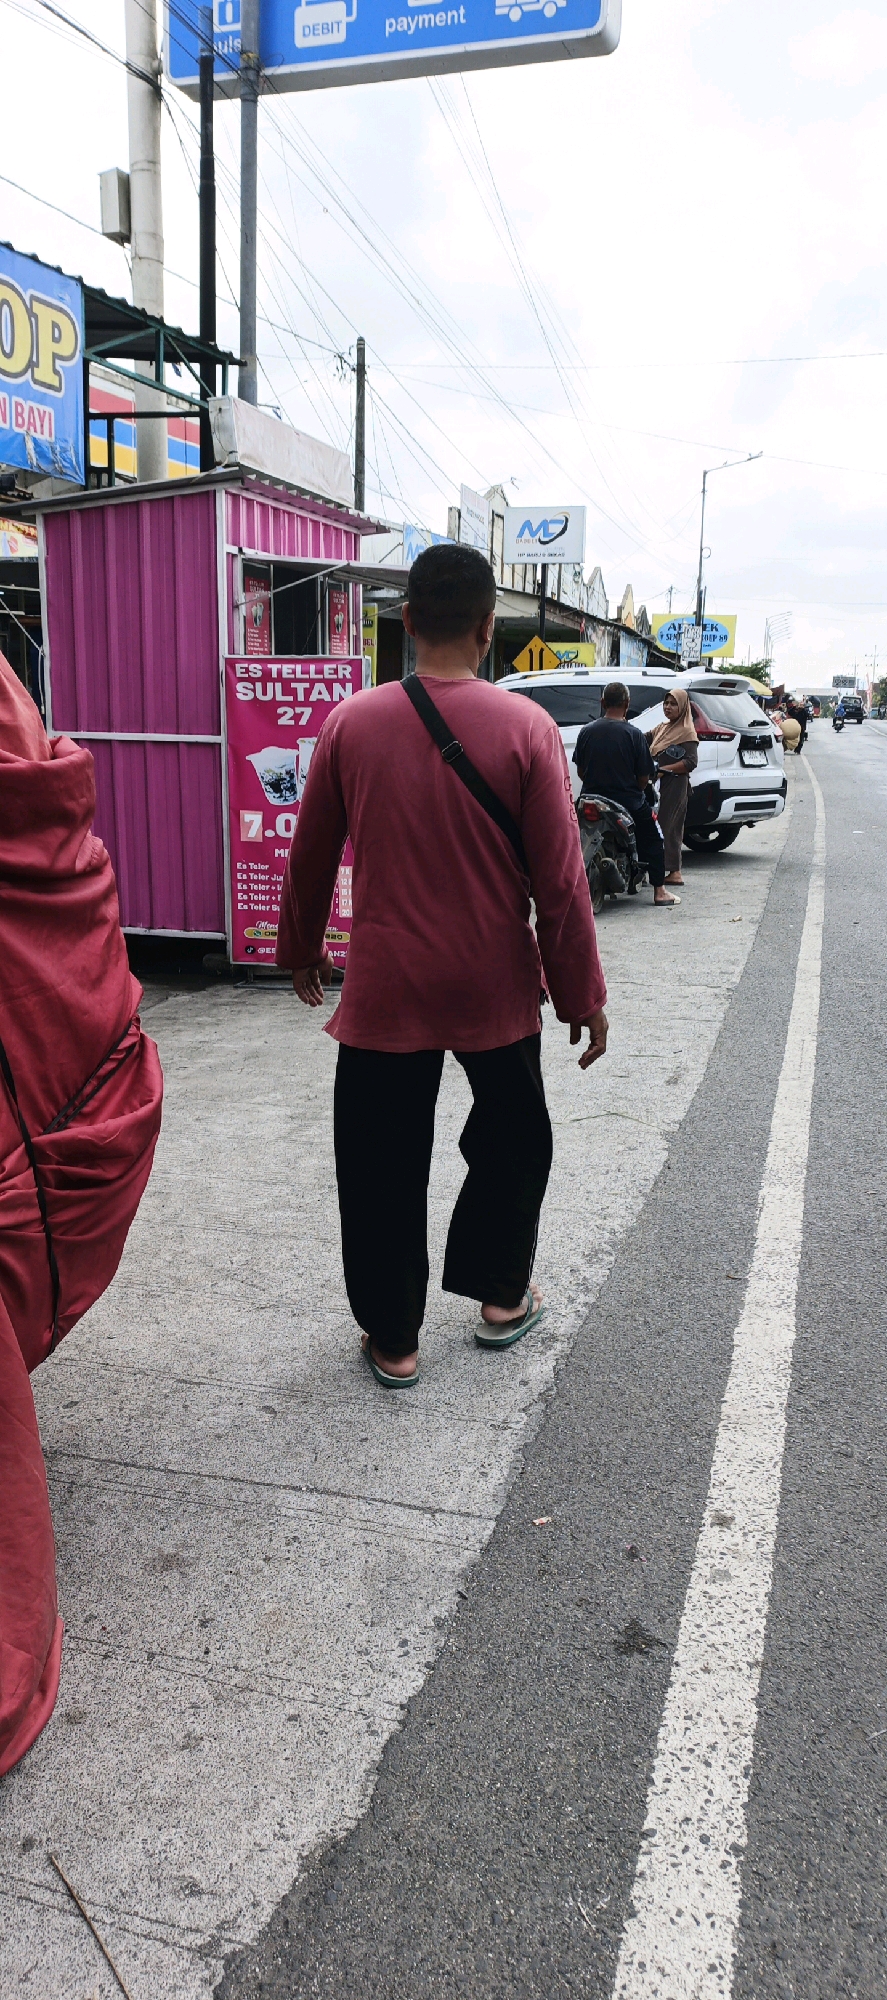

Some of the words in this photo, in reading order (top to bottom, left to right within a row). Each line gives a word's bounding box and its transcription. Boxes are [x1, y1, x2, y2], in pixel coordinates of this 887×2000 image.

[385, 5, 466, 37] payment
[302, 21, 342, 38] DEBIT
[15, 400, 53, 438] BAYI
[235, 663, 262, 678] ES
[267, 663, 352, 679] TELLER
[235, 682, 353, 702] SULTAN
[276, 706, 312, 726] 27
[236, 862, 247, 870] Es
[249, 862, 270, 871] Teler
[237, 872, 247, 880] Es
[249, 872, 270, 881] Teler
[237, 882, 248, 890] Es
[249, 883, 271, 891] Teler
[237, 892, 248, 901] Es
[249, 892, 271, 901] Teler
[237, 902, 249, 911] Es
[249, 903, 271, 912] Teler
